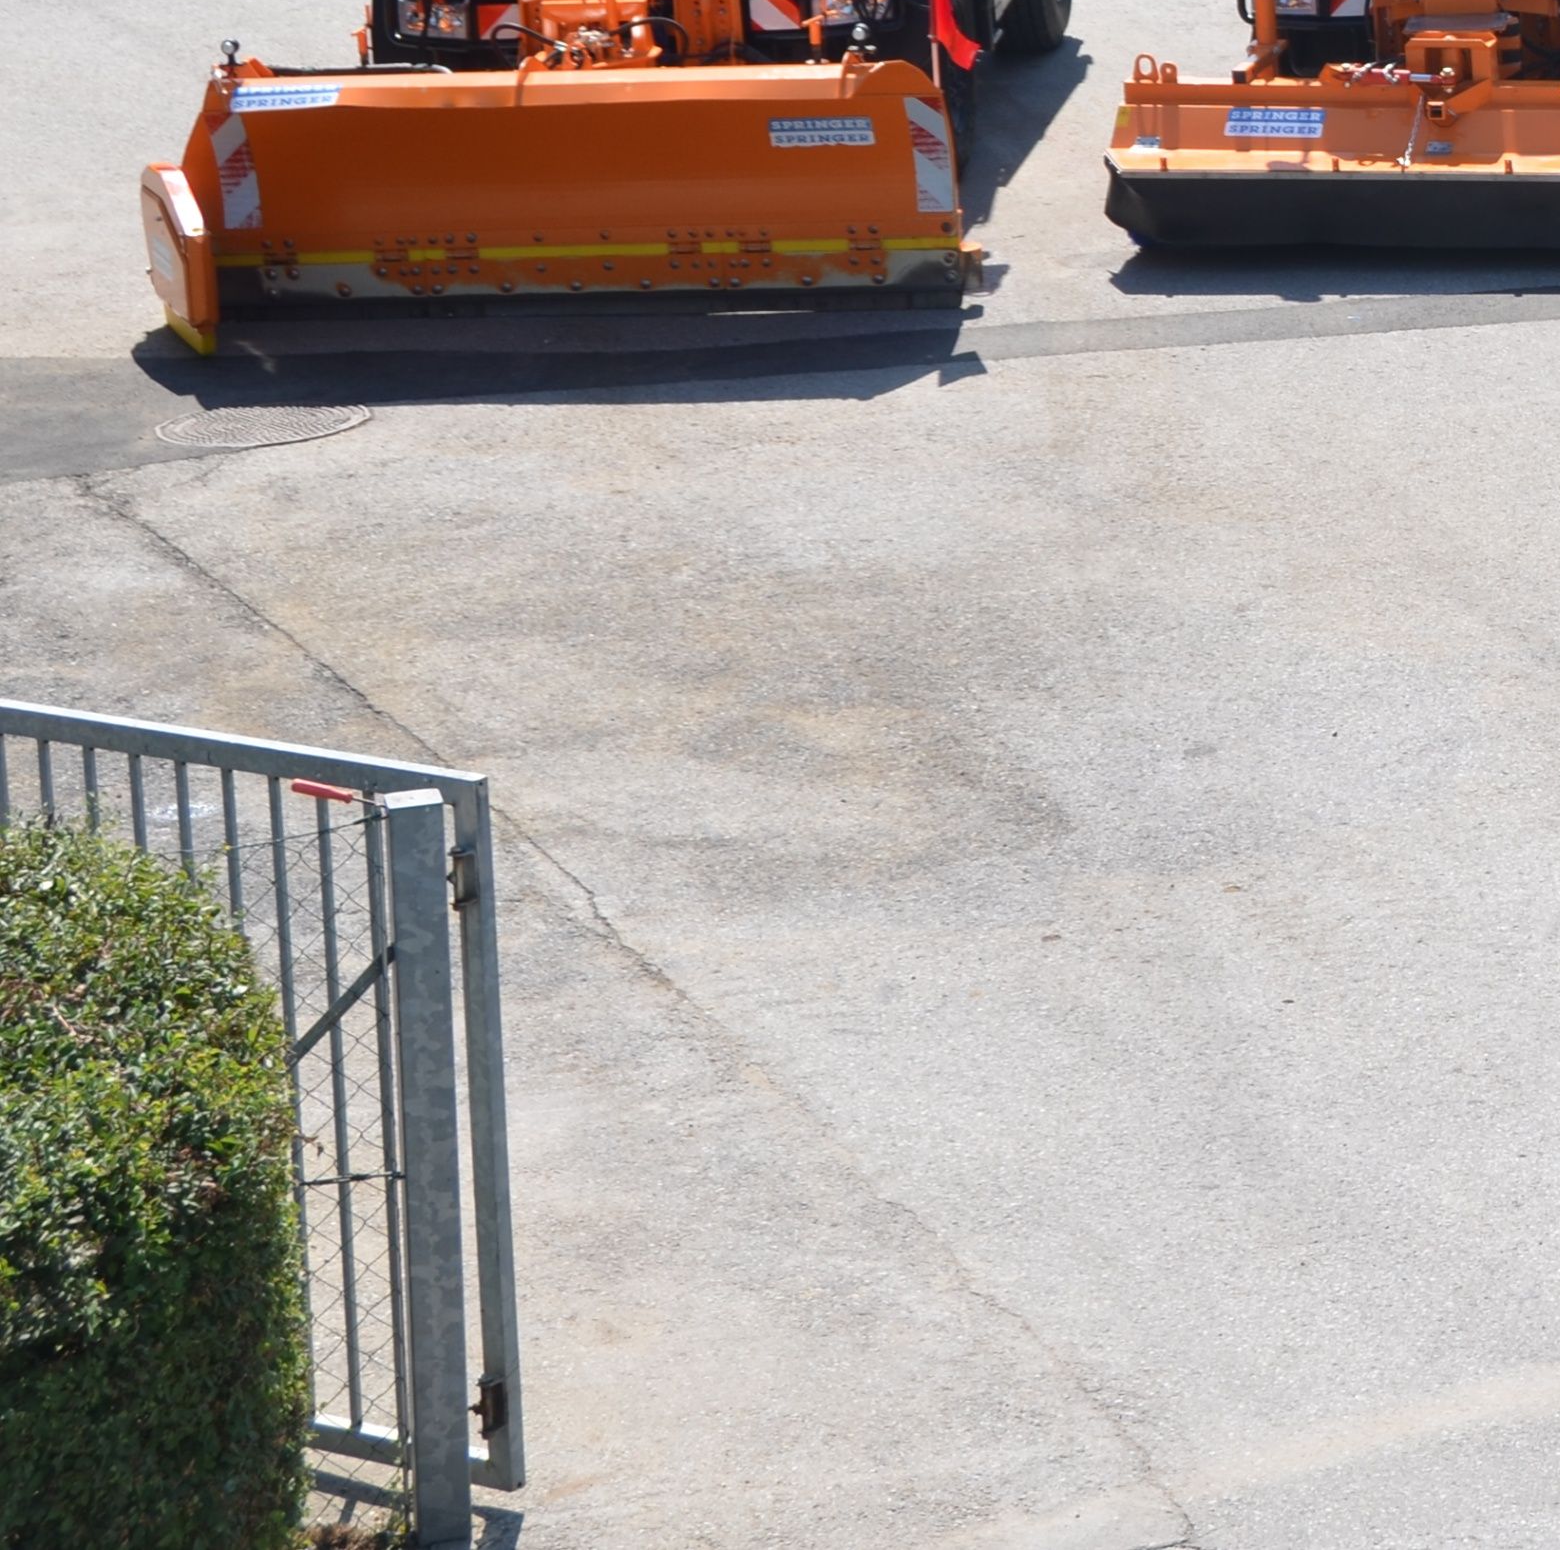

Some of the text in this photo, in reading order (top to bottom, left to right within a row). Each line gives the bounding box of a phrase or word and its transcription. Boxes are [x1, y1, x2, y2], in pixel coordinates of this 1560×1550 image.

[233, 95, 333, 108] SPRINGER
[1230, 110, 1321, 121] SPRINGER
[771, 119, 868, 130] SPRINGER
[1228, 125, 1319, 135] SPRINGER
[775, 134, 870, 144] SPRINGER
